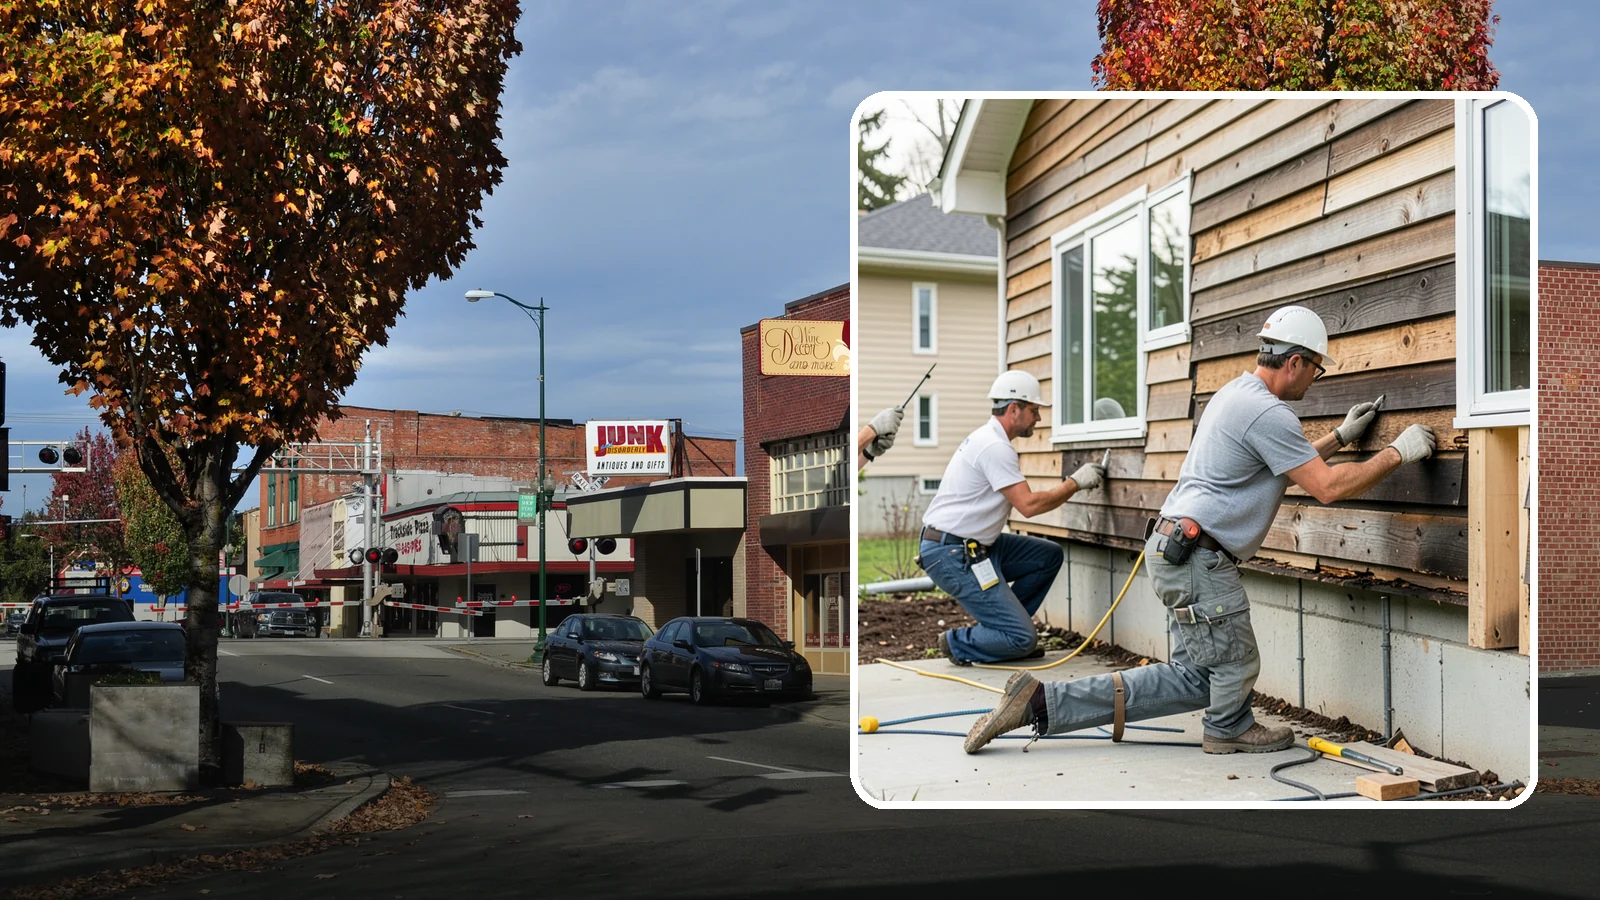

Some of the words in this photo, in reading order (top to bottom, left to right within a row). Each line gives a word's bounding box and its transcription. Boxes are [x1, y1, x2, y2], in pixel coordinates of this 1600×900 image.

[765, 327, 830, 365] Decor
[595, 425, 665, 457] JUNK
[607, 446, 646, 454] DISORDERLY
[597, 461, 628, 470] ANTIQUES
[631, 461, 643, 470] AND
[647, 460, 665, 469] GIFTS
[573, 474, 588, 490] RAIL
[414, 519, 429, 535] Pizza
